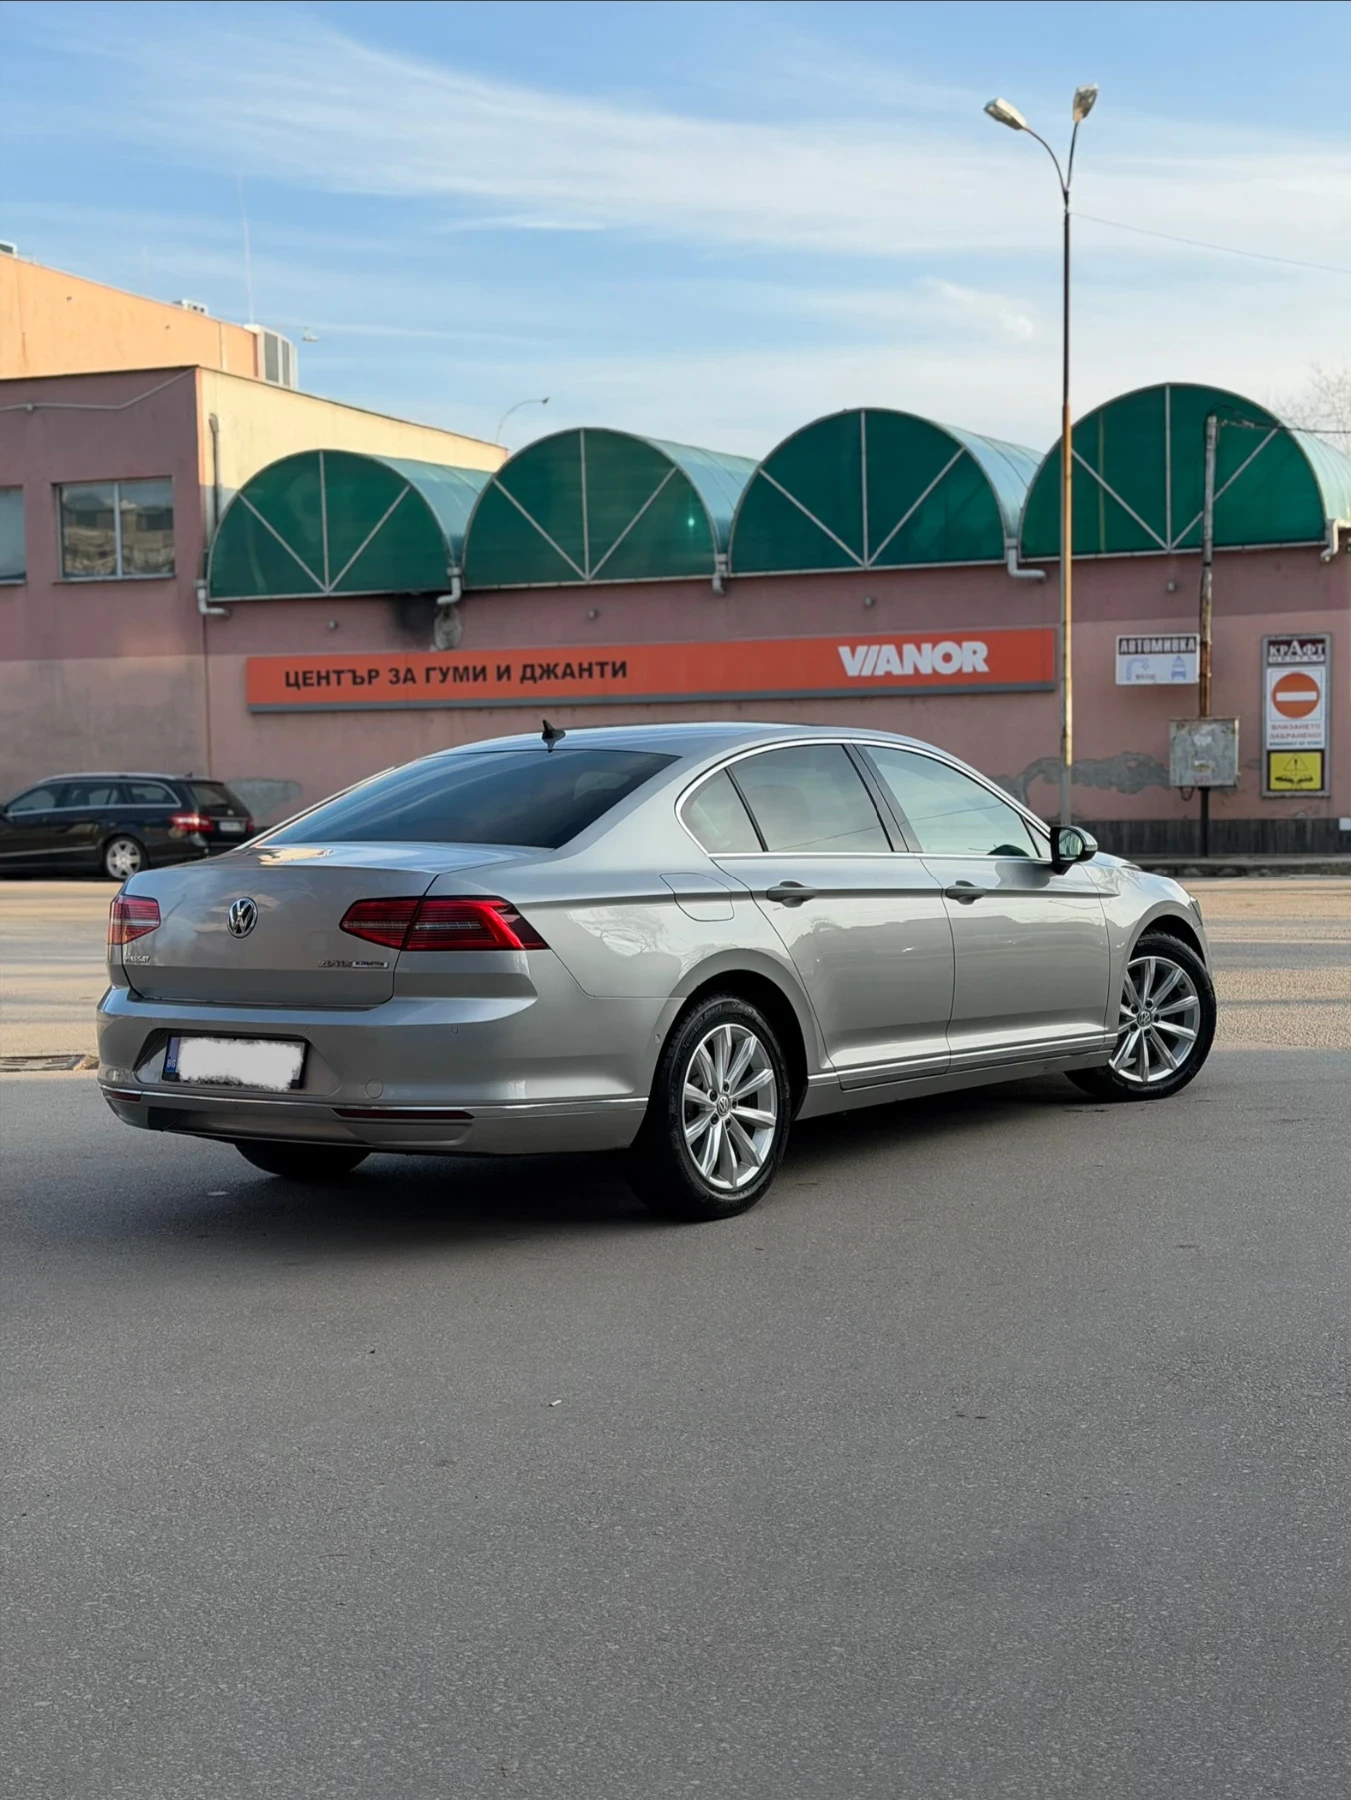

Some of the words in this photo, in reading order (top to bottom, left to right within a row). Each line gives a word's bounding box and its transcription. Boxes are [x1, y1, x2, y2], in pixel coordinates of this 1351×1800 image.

[1120, 638, 1196, 653] АВТОМИВКА
[1269, 640, 1325, 656] КРАФТ
[837, 641, 990, 677] VIANOR
[285, 669, 380, 690] ЦЕНТЪР
[389, 667, 416, 685] ЗА
[425, 665, 487, 684] ГУМИ
[496, 664, 512, 682] И
[520, 660, 628, 685] ДЖАНТИ
[166, 1059, 177, 1068] BG
